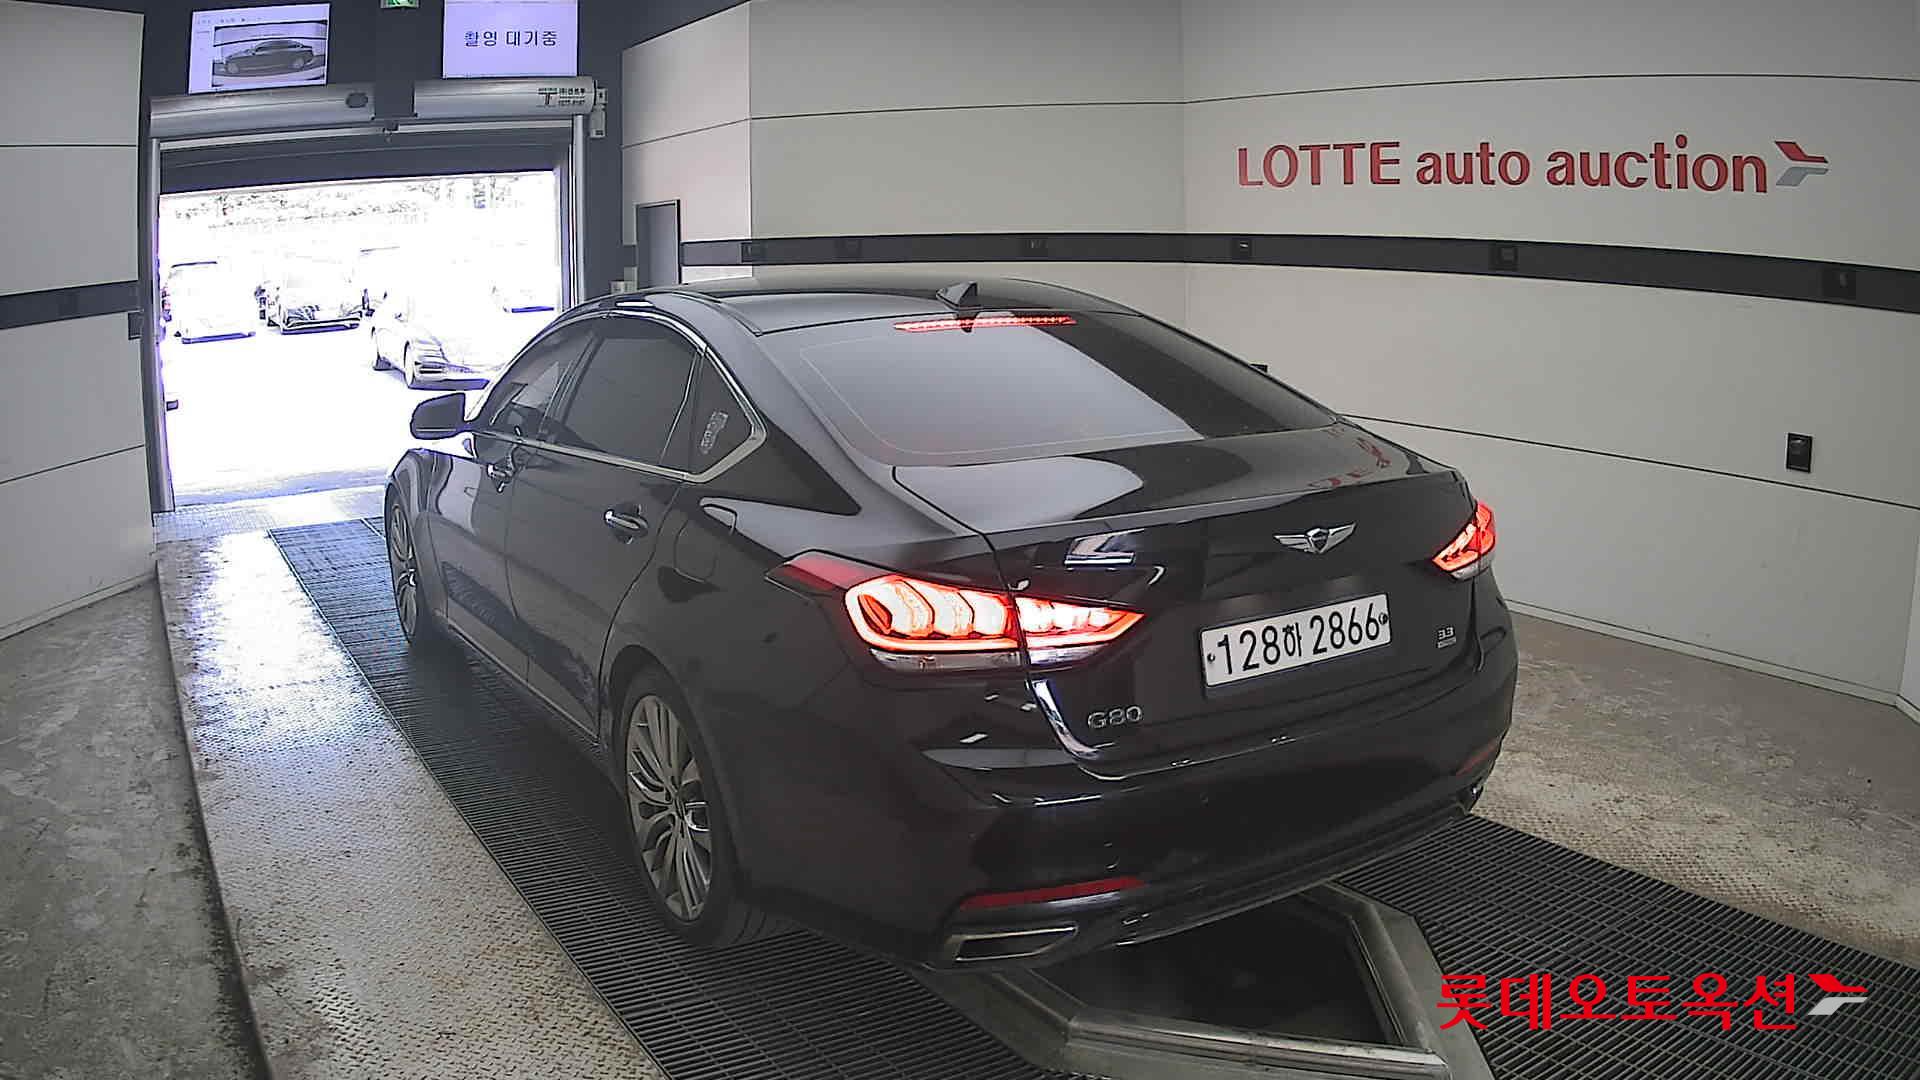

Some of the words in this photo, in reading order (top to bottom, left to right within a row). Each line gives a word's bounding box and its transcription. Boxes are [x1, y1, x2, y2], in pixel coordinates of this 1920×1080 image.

[505, 31, 557, 47] 대기중
[1238, 142, 1400, 187] LOTTE
[1416, 141, 1531, 186] auto
[1546, 134, 1767, 193] auction
[1217, 621, 1302, 675] 128하
[1309, 602, 1380, 655] 2866
[1087, 705, 1143, 729] G80
